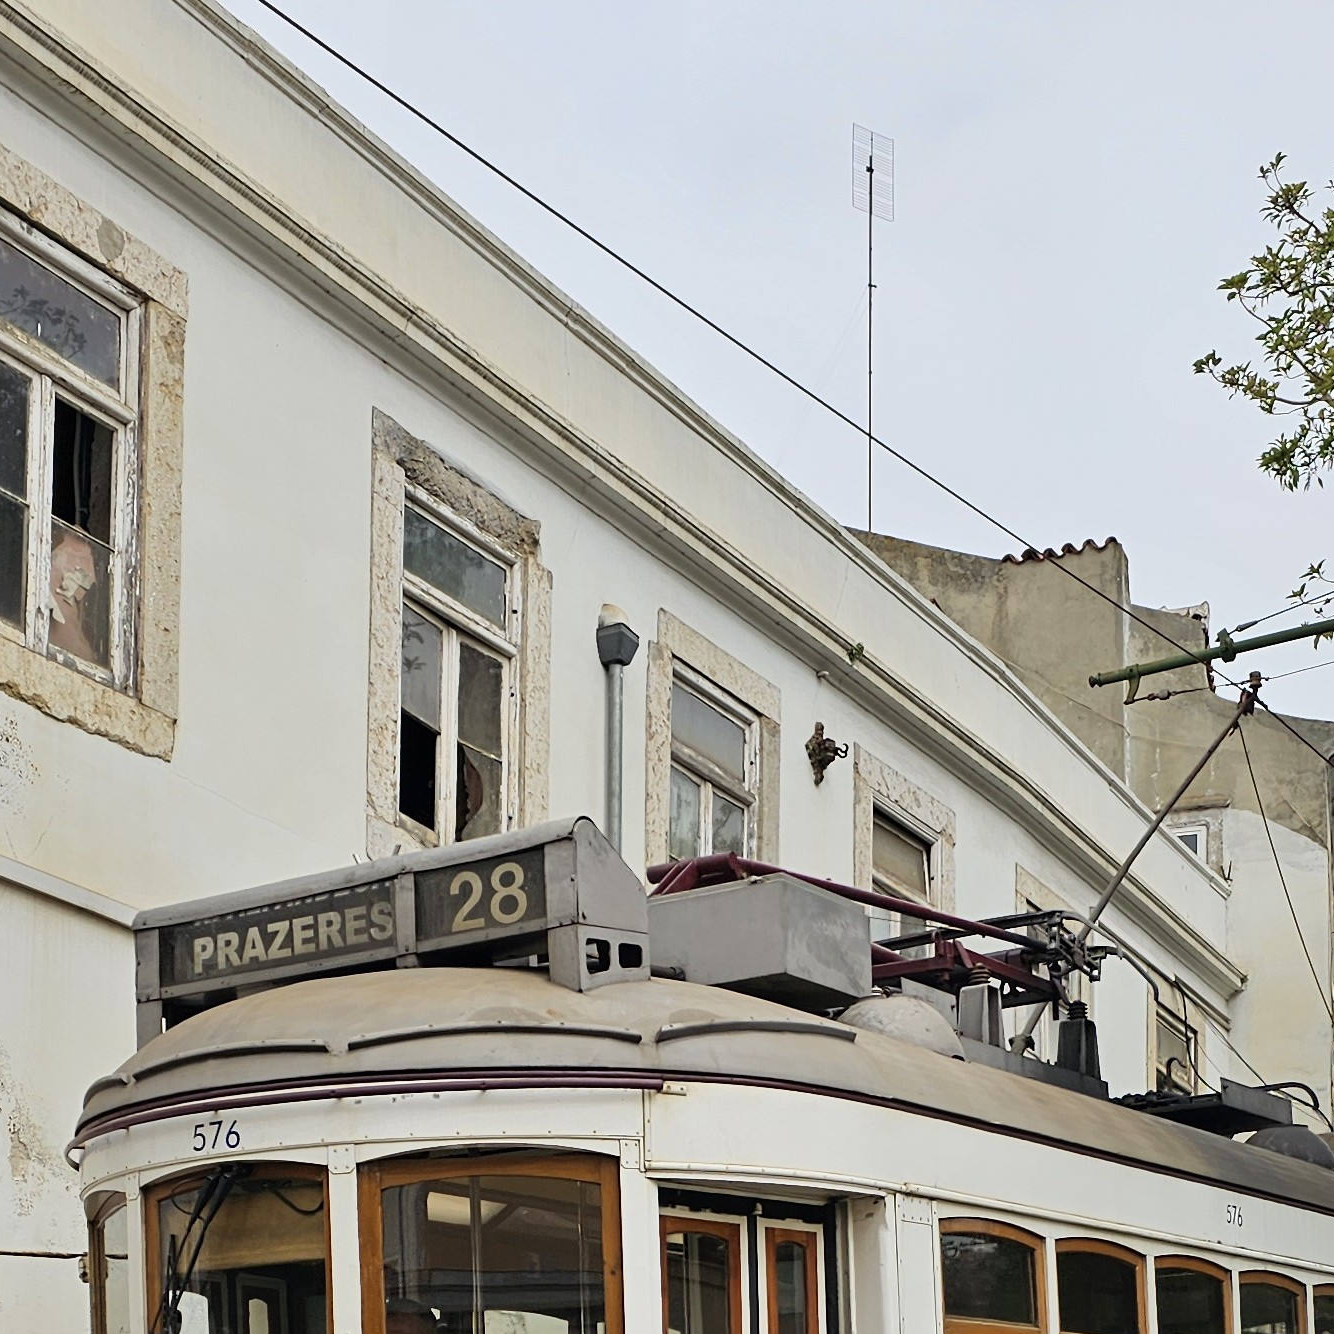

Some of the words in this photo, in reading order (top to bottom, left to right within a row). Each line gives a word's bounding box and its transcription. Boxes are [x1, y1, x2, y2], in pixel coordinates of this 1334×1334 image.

[450, 862, 528, 932] 28
[193, 901, 395, 974] PRAZERES
[193, 1119, 241, 1152] 576
[1226, 1204, 1243, 1228] 576
